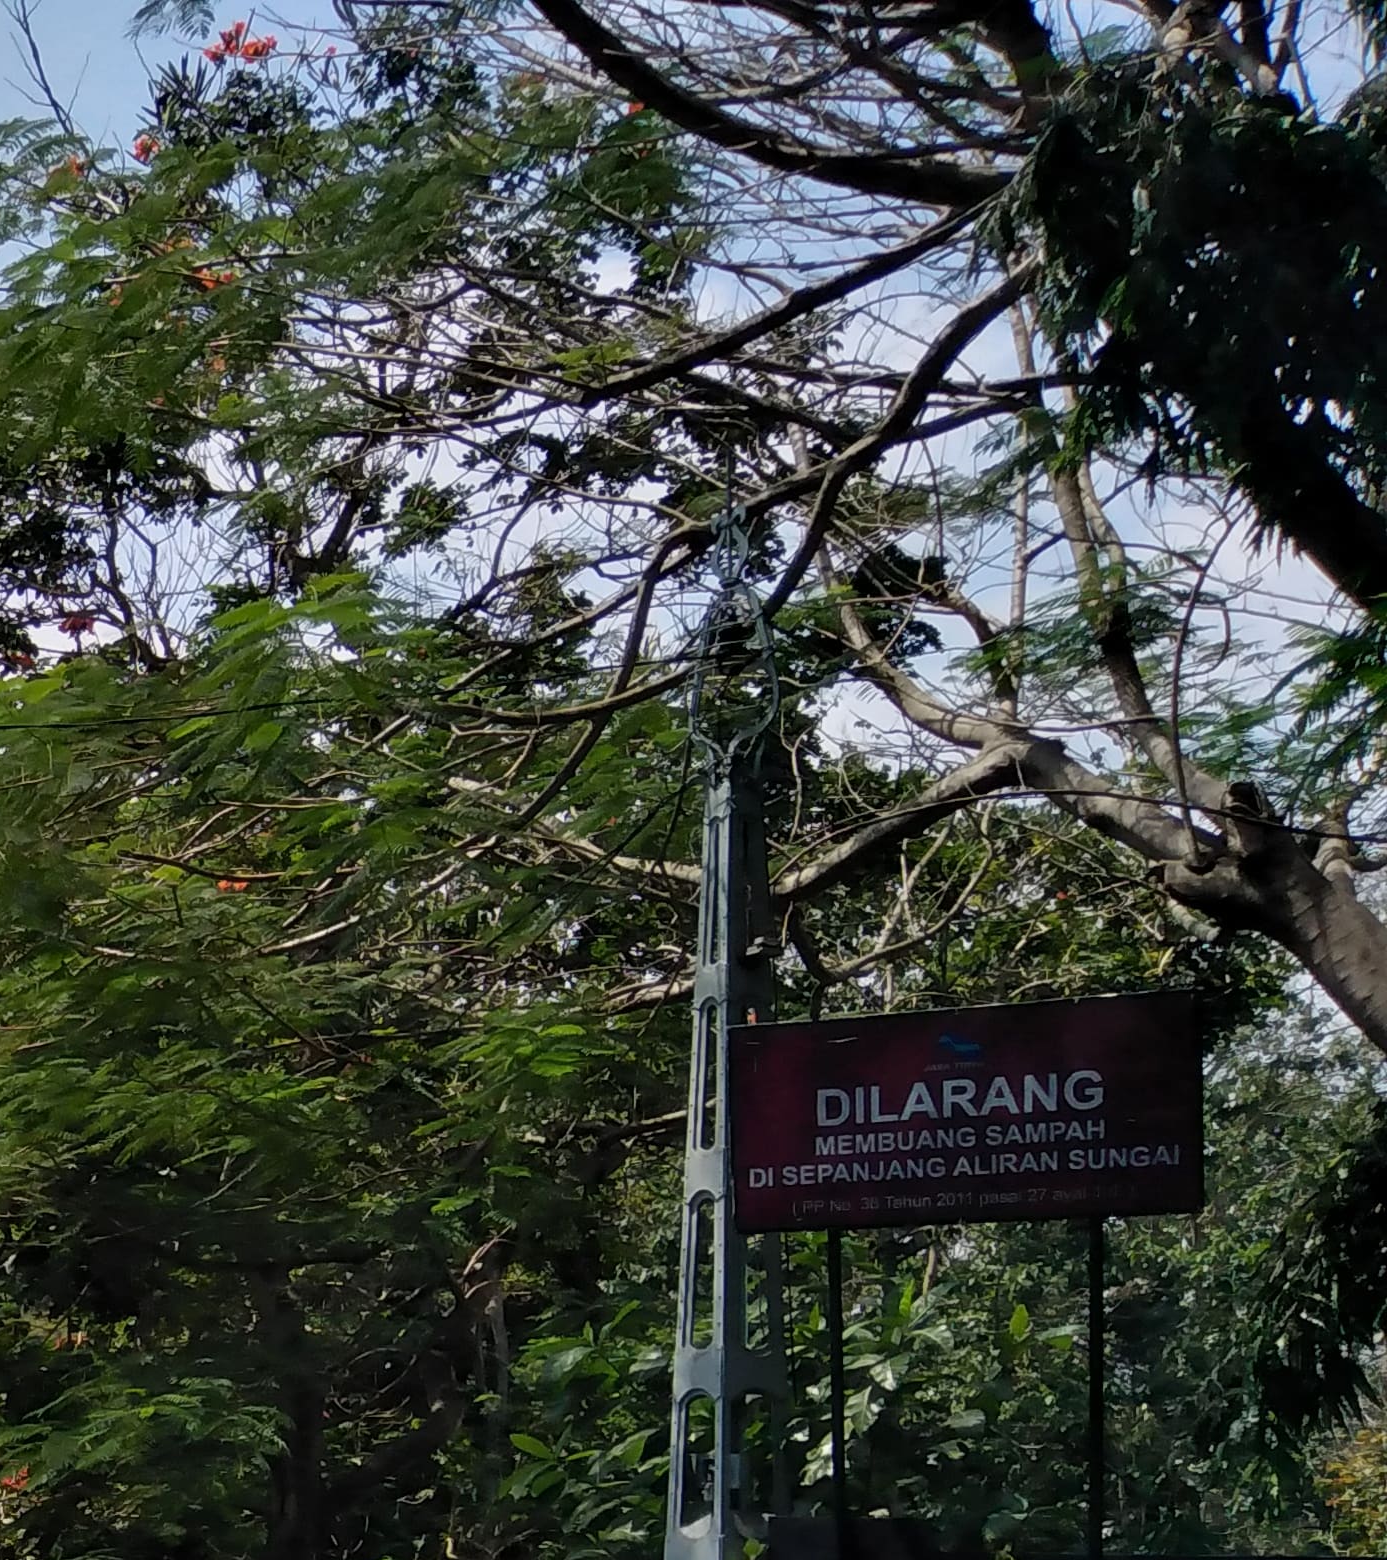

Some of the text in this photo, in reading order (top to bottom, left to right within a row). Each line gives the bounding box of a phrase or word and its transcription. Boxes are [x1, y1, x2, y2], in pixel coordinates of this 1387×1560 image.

[816, 1070, 1105, 1127] DILARANG
[815, 1119, 1106, 1156] MEMBUANG SAMPAH
[748, 1144, 1181, 1189] DI SEPANJANG ALIRAN SUNGAI
[885, 1195, 932, 1210] Tahun
[936, 1192, 973, 1208] 2011
[1027, 1188, 1047, 1202] 27
